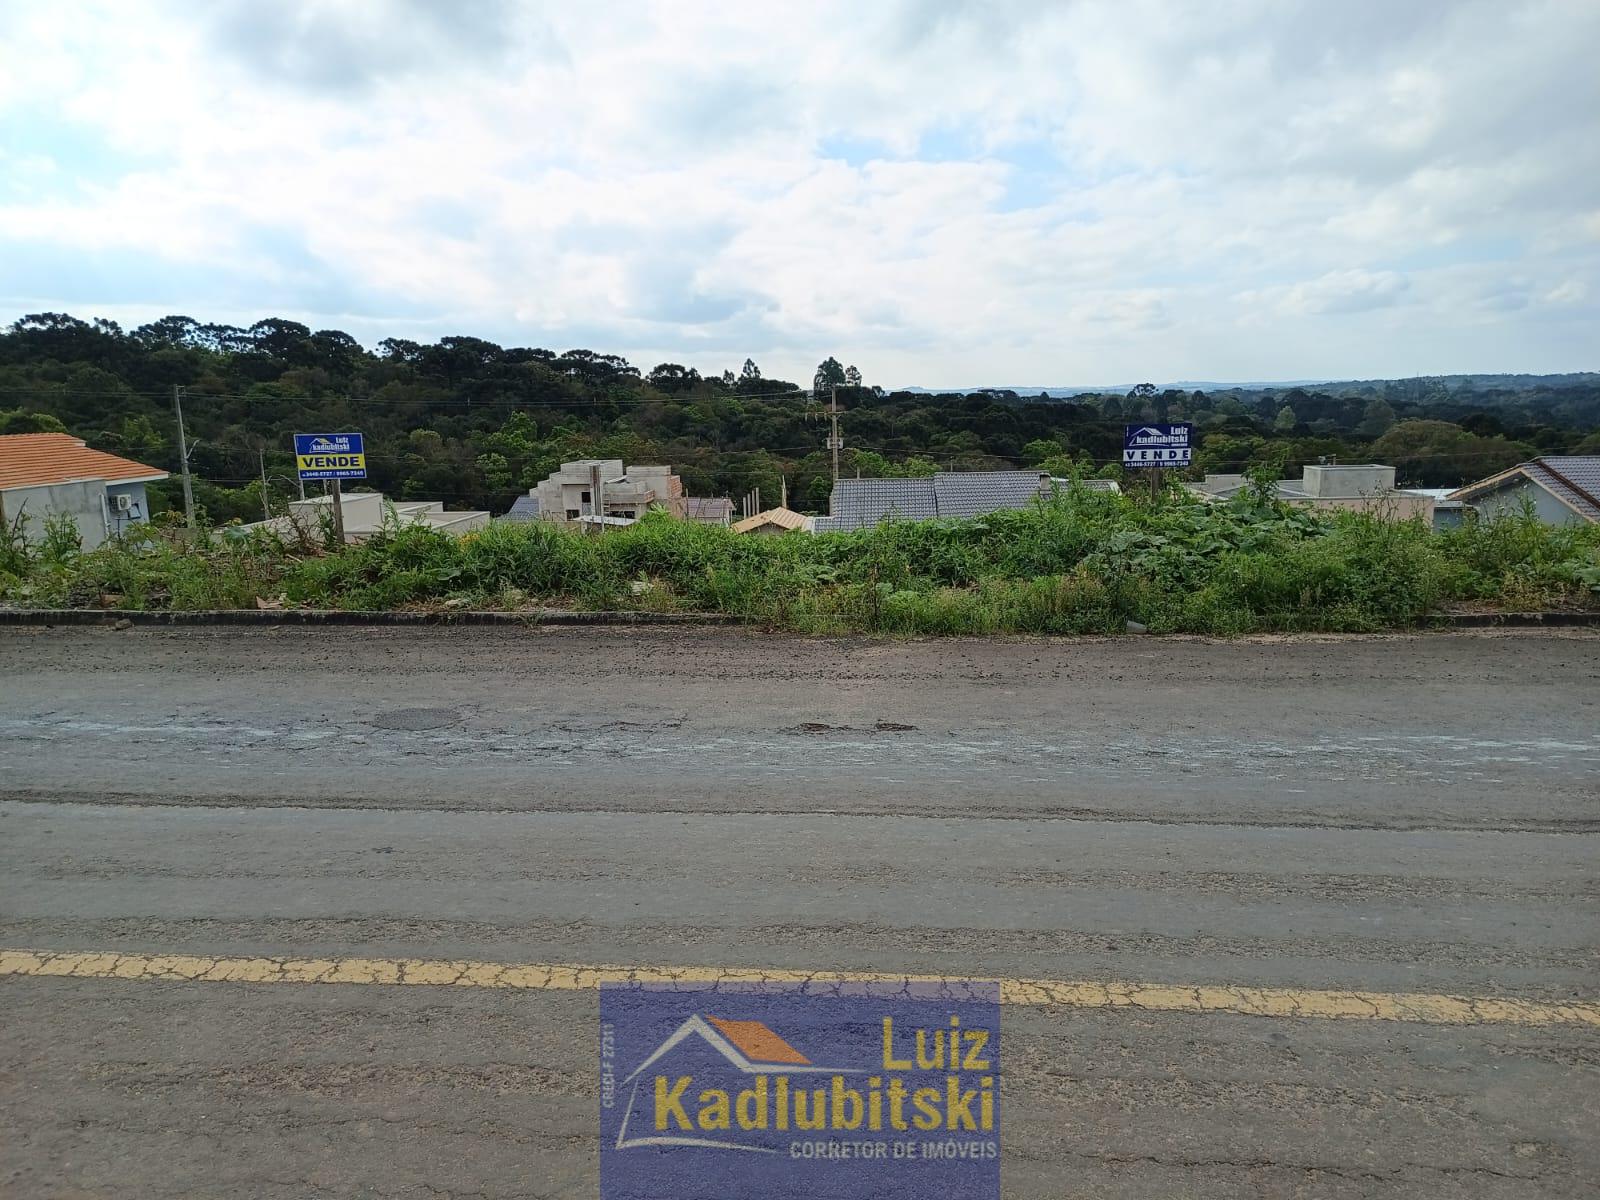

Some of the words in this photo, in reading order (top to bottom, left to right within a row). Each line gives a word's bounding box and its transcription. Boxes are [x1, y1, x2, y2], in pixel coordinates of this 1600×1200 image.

[1170, 426, 1188, 435] Luiz
[335, 436, 349, 444] Luiz
[1126, 450, 1189, 460] VENDE
[302, 456, 360, 468] VENDE
